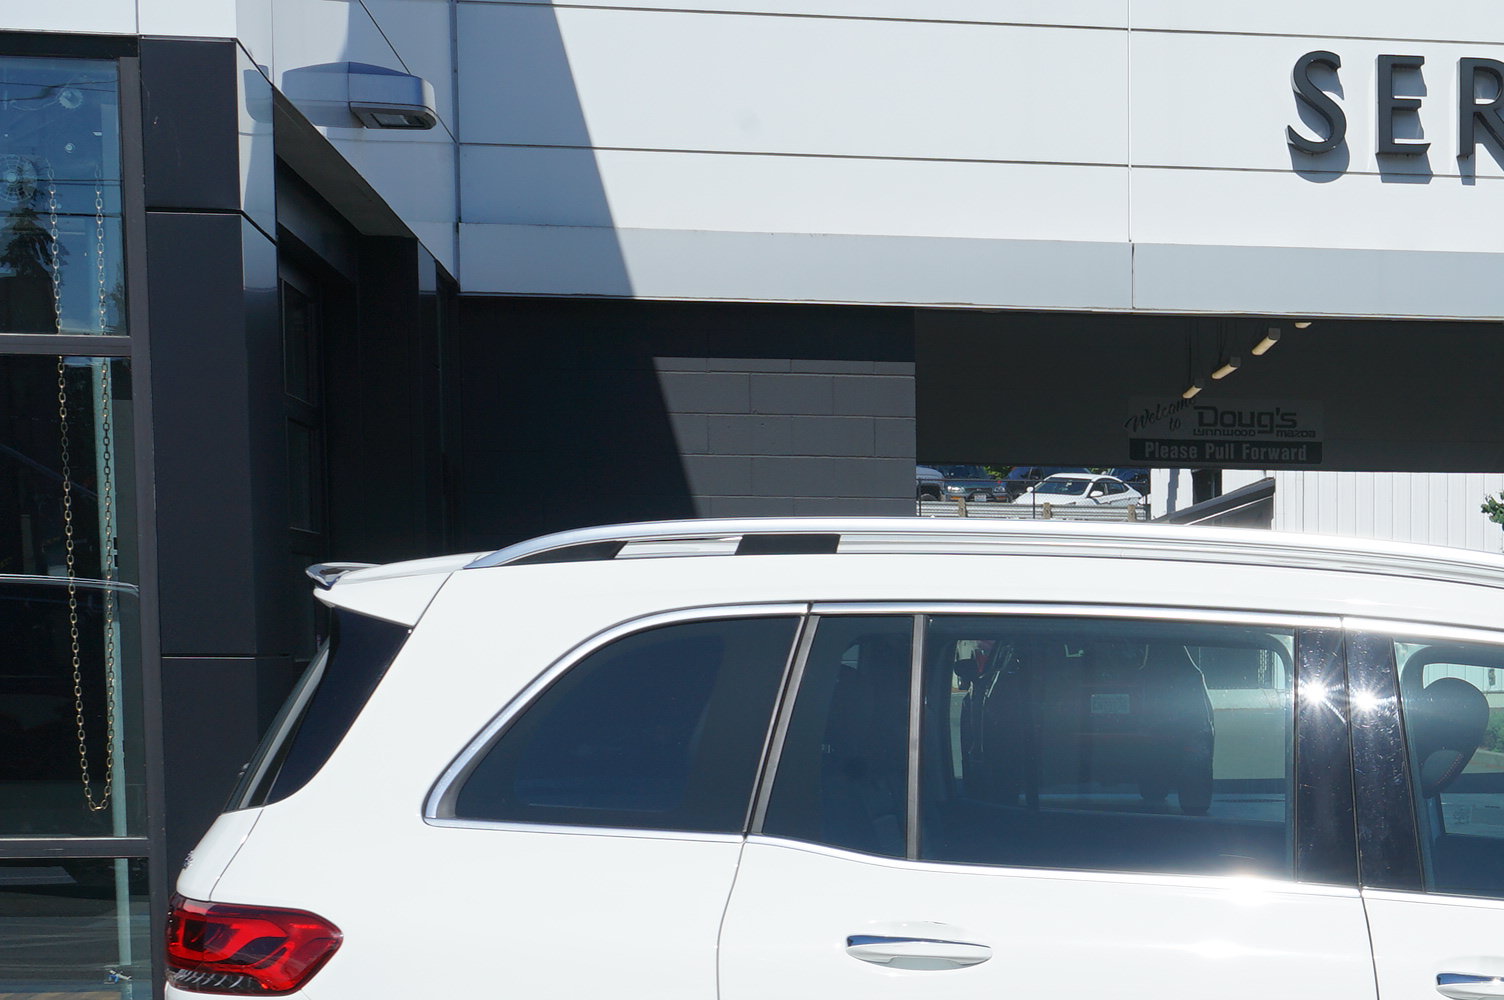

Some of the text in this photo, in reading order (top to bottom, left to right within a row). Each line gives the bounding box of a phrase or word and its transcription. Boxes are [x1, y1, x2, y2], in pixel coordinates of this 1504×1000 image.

[1194, 406, 1297, 434] Doug's
[1145, 441, 1308, 461] Please Pull Forward
